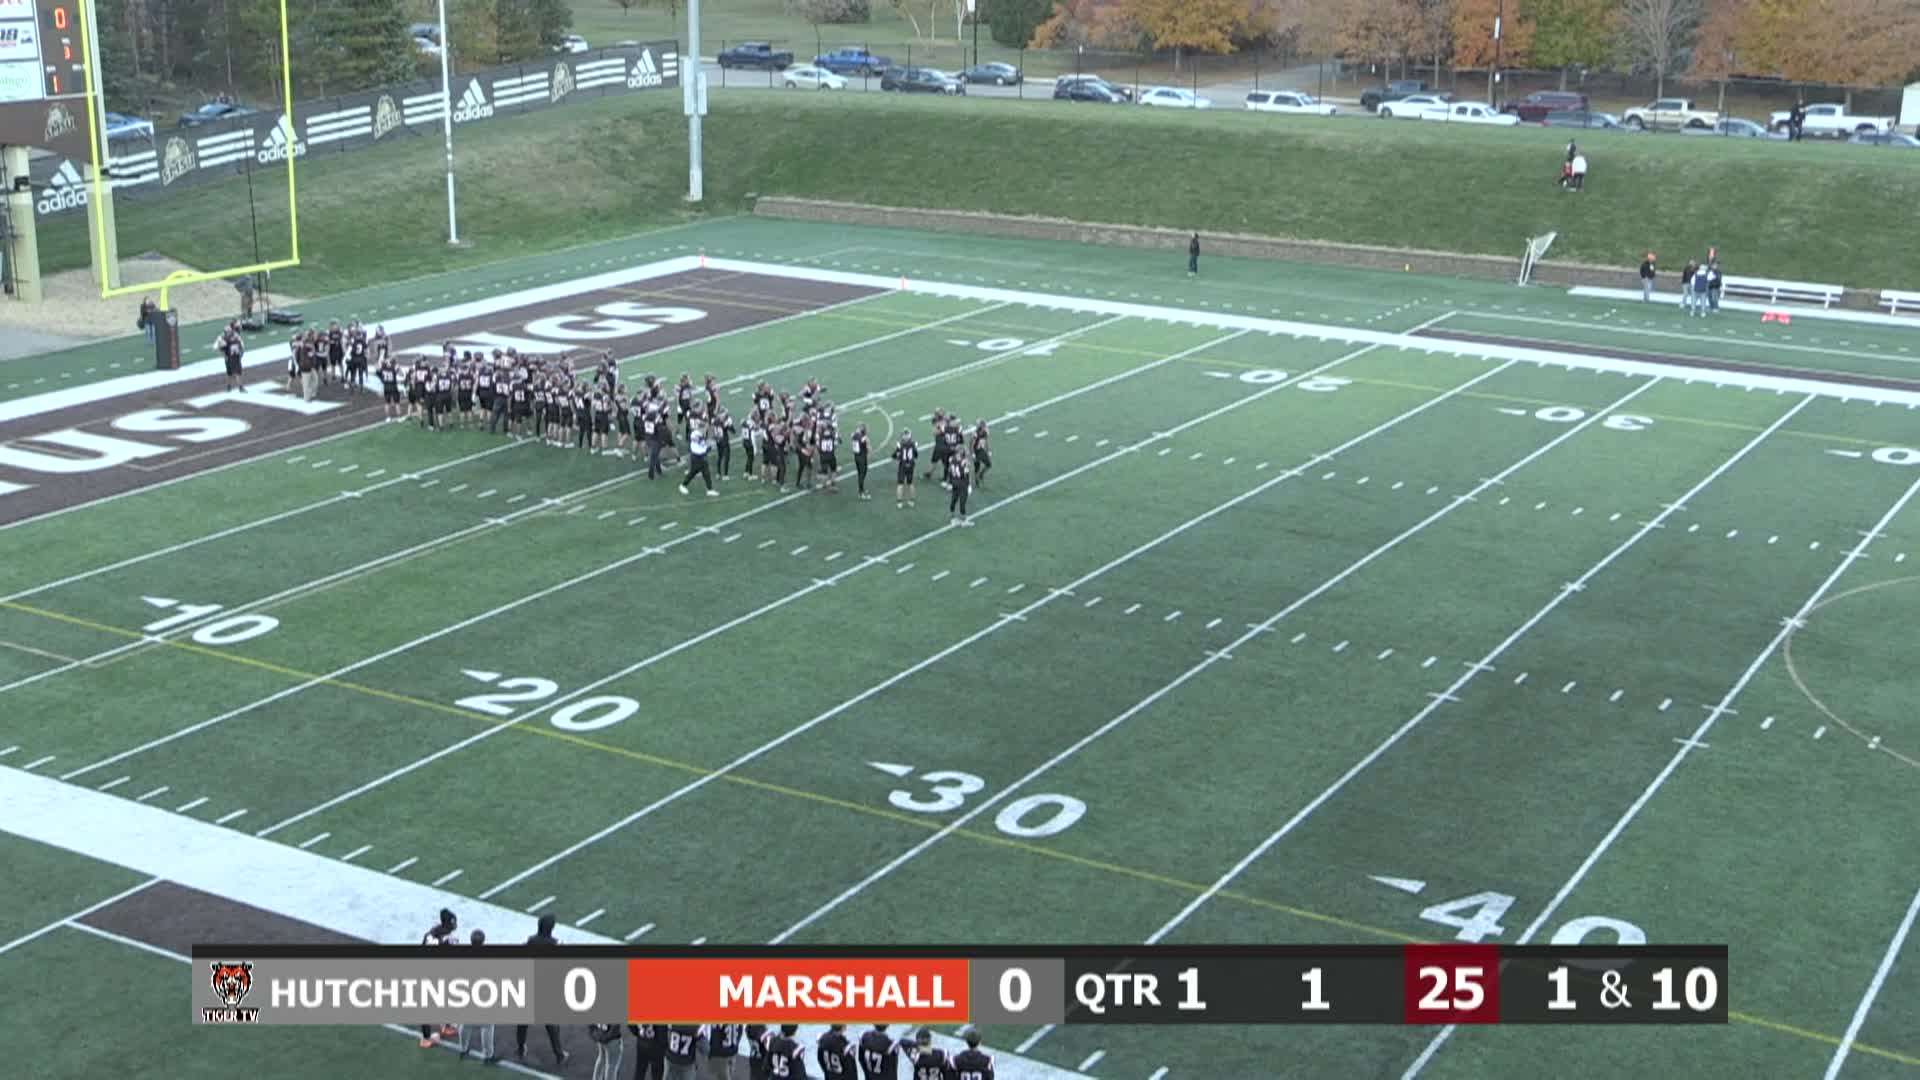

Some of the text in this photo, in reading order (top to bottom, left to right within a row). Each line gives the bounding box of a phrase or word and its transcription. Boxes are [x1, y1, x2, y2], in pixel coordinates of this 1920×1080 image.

[54, 7, 66, 29] 0
[627, 73, 662, 89] adidas
[453, 104, 494, 122] adidas
[38, 187, 88, 215] adida
[142, 603, 280, 645] 10
[454, 676, 641, 732] 20
[887, 770, 1088, 838] 30
[670, 1031, 693, 1055] 87
[823, 1050, 843, 1074] 19
[863, 1050, 883, 1074] 17
